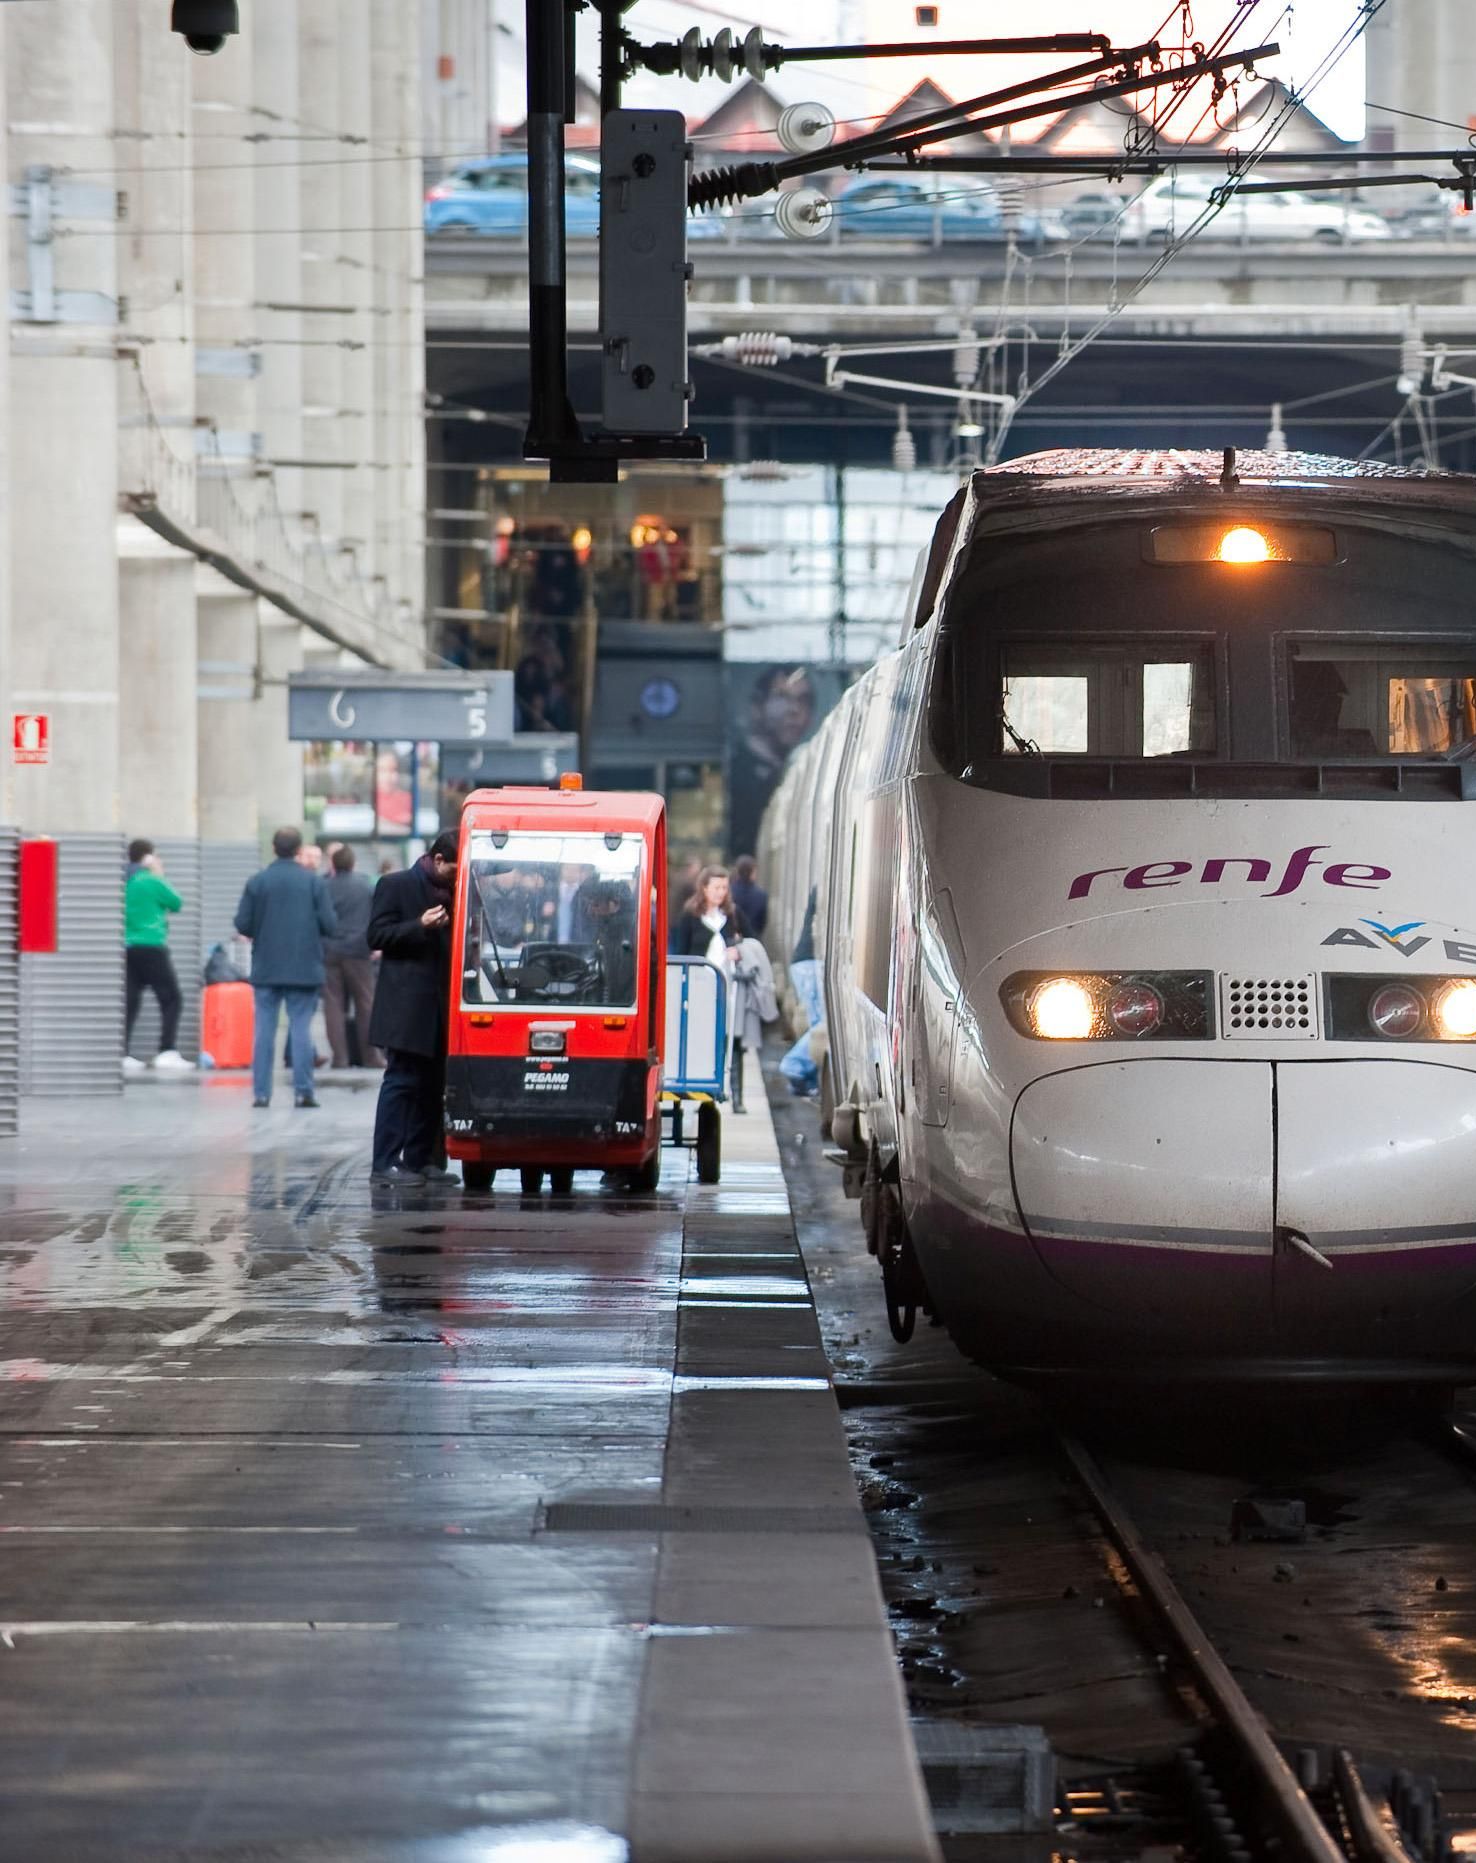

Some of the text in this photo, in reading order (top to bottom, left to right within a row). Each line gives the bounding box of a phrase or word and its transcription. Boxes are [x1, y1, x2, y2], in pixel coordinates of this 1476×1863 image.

[469, 709, 487, 737] 5
[1068, 845, 1392, 900] renfe
[524, 1072, 570, 1083] PEGAMO
